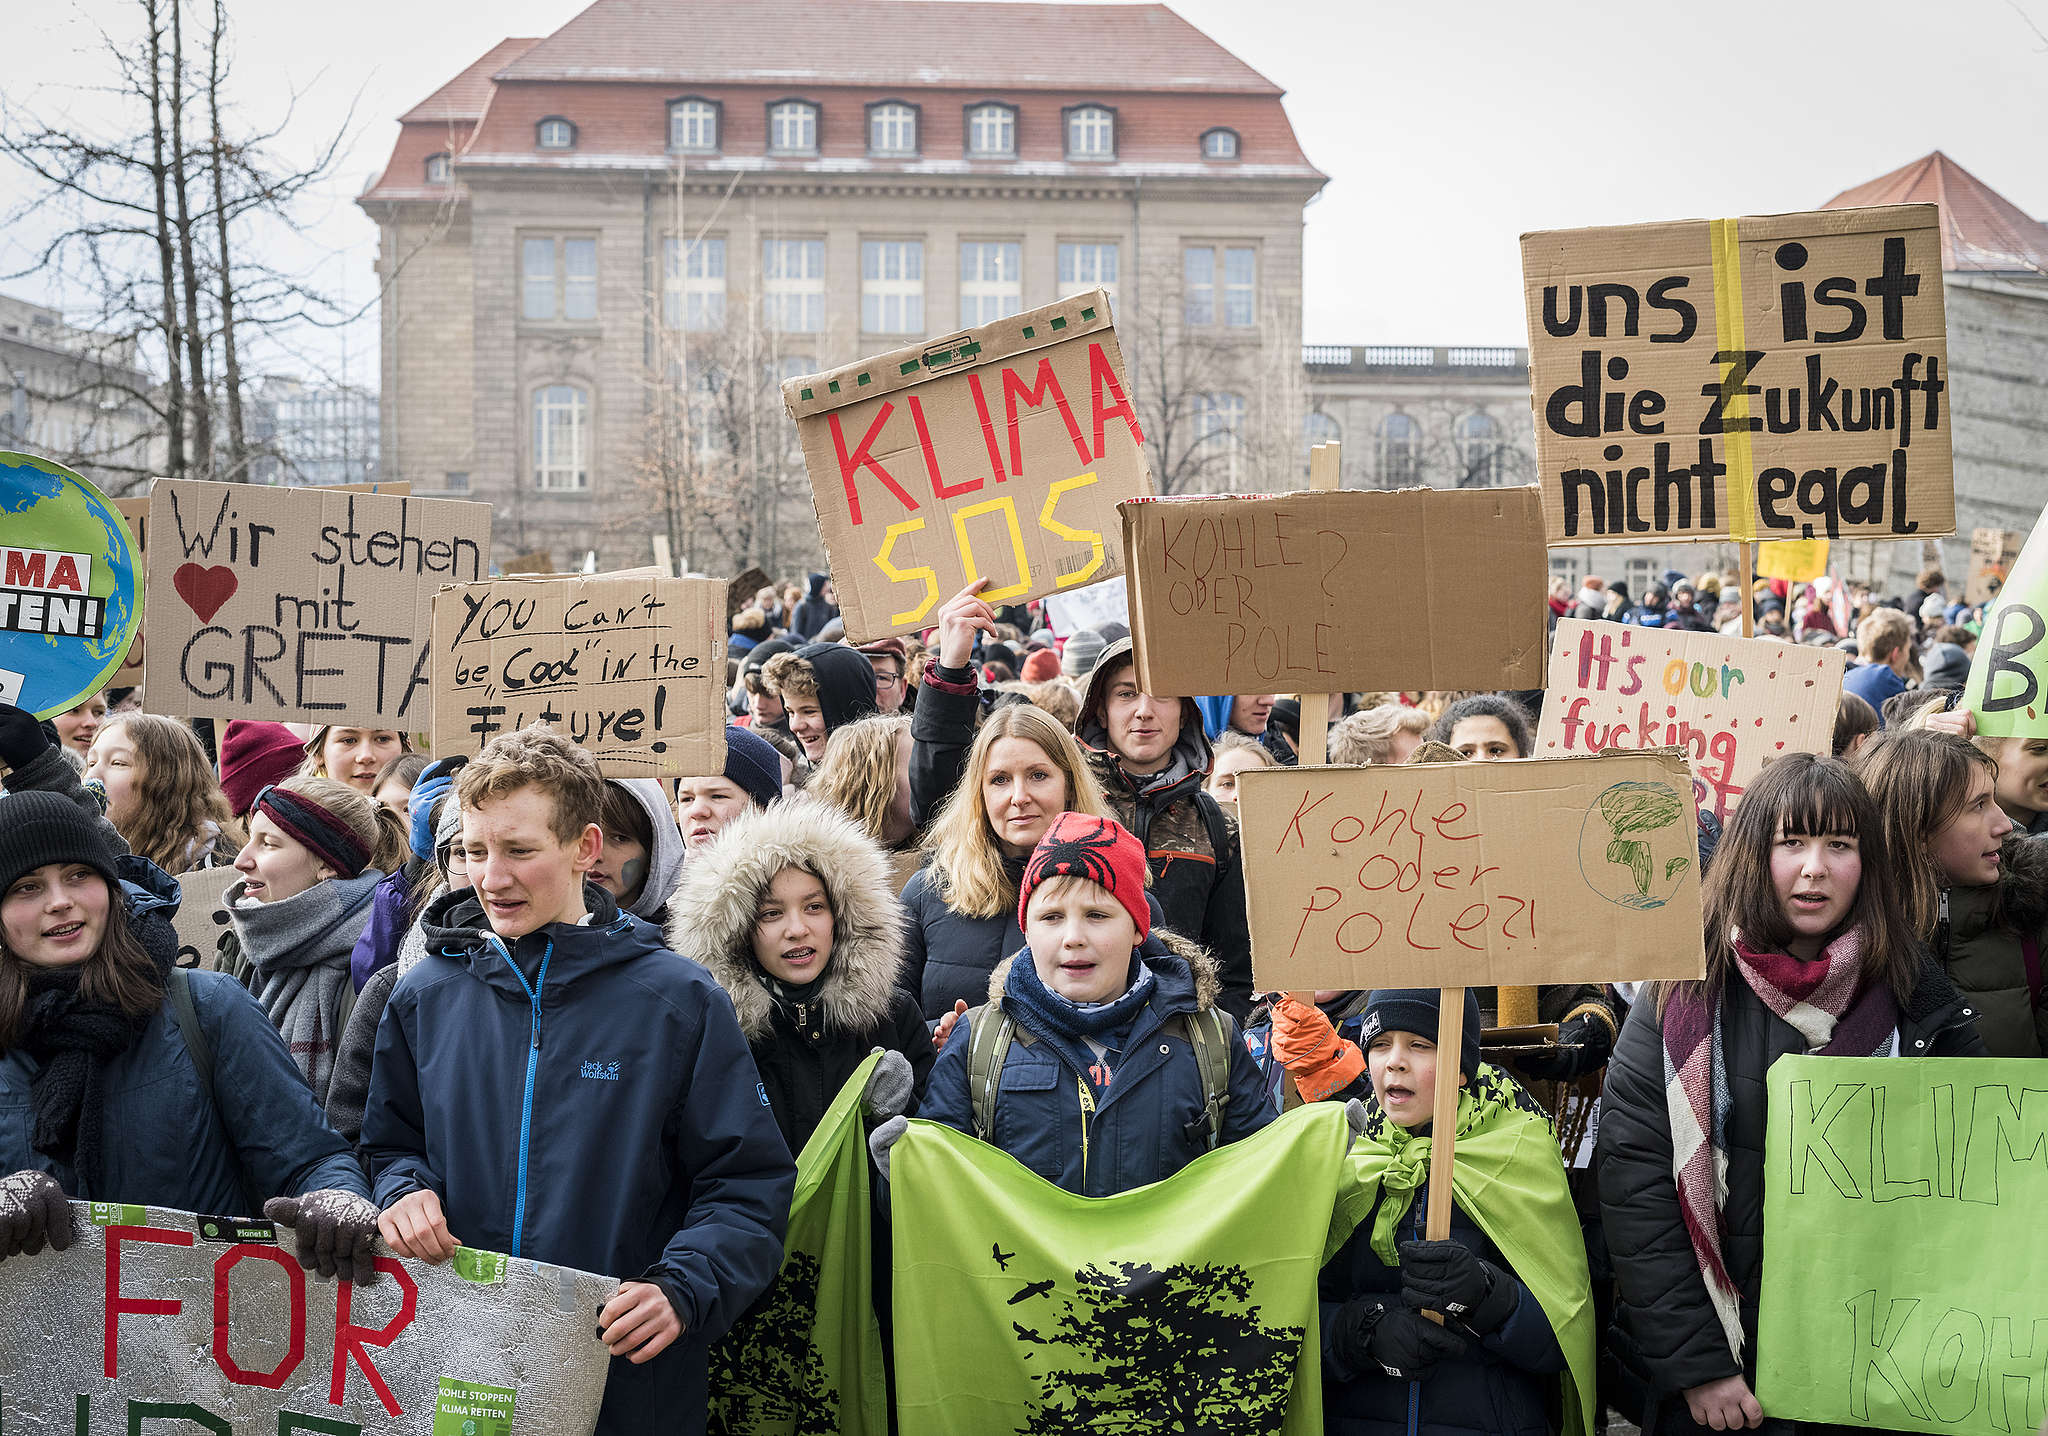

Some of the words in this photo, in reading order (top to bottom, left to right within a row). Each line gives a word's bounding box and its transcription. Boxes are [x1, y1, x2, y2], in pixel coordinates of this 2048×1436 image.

[1542, 275, 1698, 343] uns
[1774, 237, 1921, 343] ist
[1545, 350, 1666, 438] die
[1699, 350, 1945, 448] Zukunft
[826, 343, 1145, 525] KLIMA
[1560, 438, 1726, 537] nicht
[1757, 448, 1919, 540] egal
[171, 489, 274, 567] Wir
[311, 495, 480, 581] stehen
[872, 472, 1104, 626] SOS
[1161, 512, 1303, 580] KOHLE
[276, 564, 360, 631] mit
[450, 592, 536, 652] YOU
[1168, 573, 1261, 619] ODER
[180, 625, 430, 718] GRETA
[456, 655, 489, 685] be
[649, 644, 700, 674] the
[1224, 623, 1337, 684] POLE
[1578, 629, 1647, 696] It's
[1662, 658, 1745, 700] our
[1981, 603, 2048, 714] B
[466, 685, 667, 753] Fture!
[1560, 696, 1738, 787] fucking
[1276, 789, 1483, 854] Kohle
[580, 1060, 604, 1071] Jack
[580, 1069, 619, 1081] Wolfskin
[236, 1229, 261, 1238] Planet
[104, 1225, 417, 1417] FOR
[438, 1386, 467, 1400] KOHLE
[469, 1391, 513, 1403] STOPPEN
[441, 1403, 468, 1416] KLIMA
[470, 1407, 506, 1419] RETTEN
